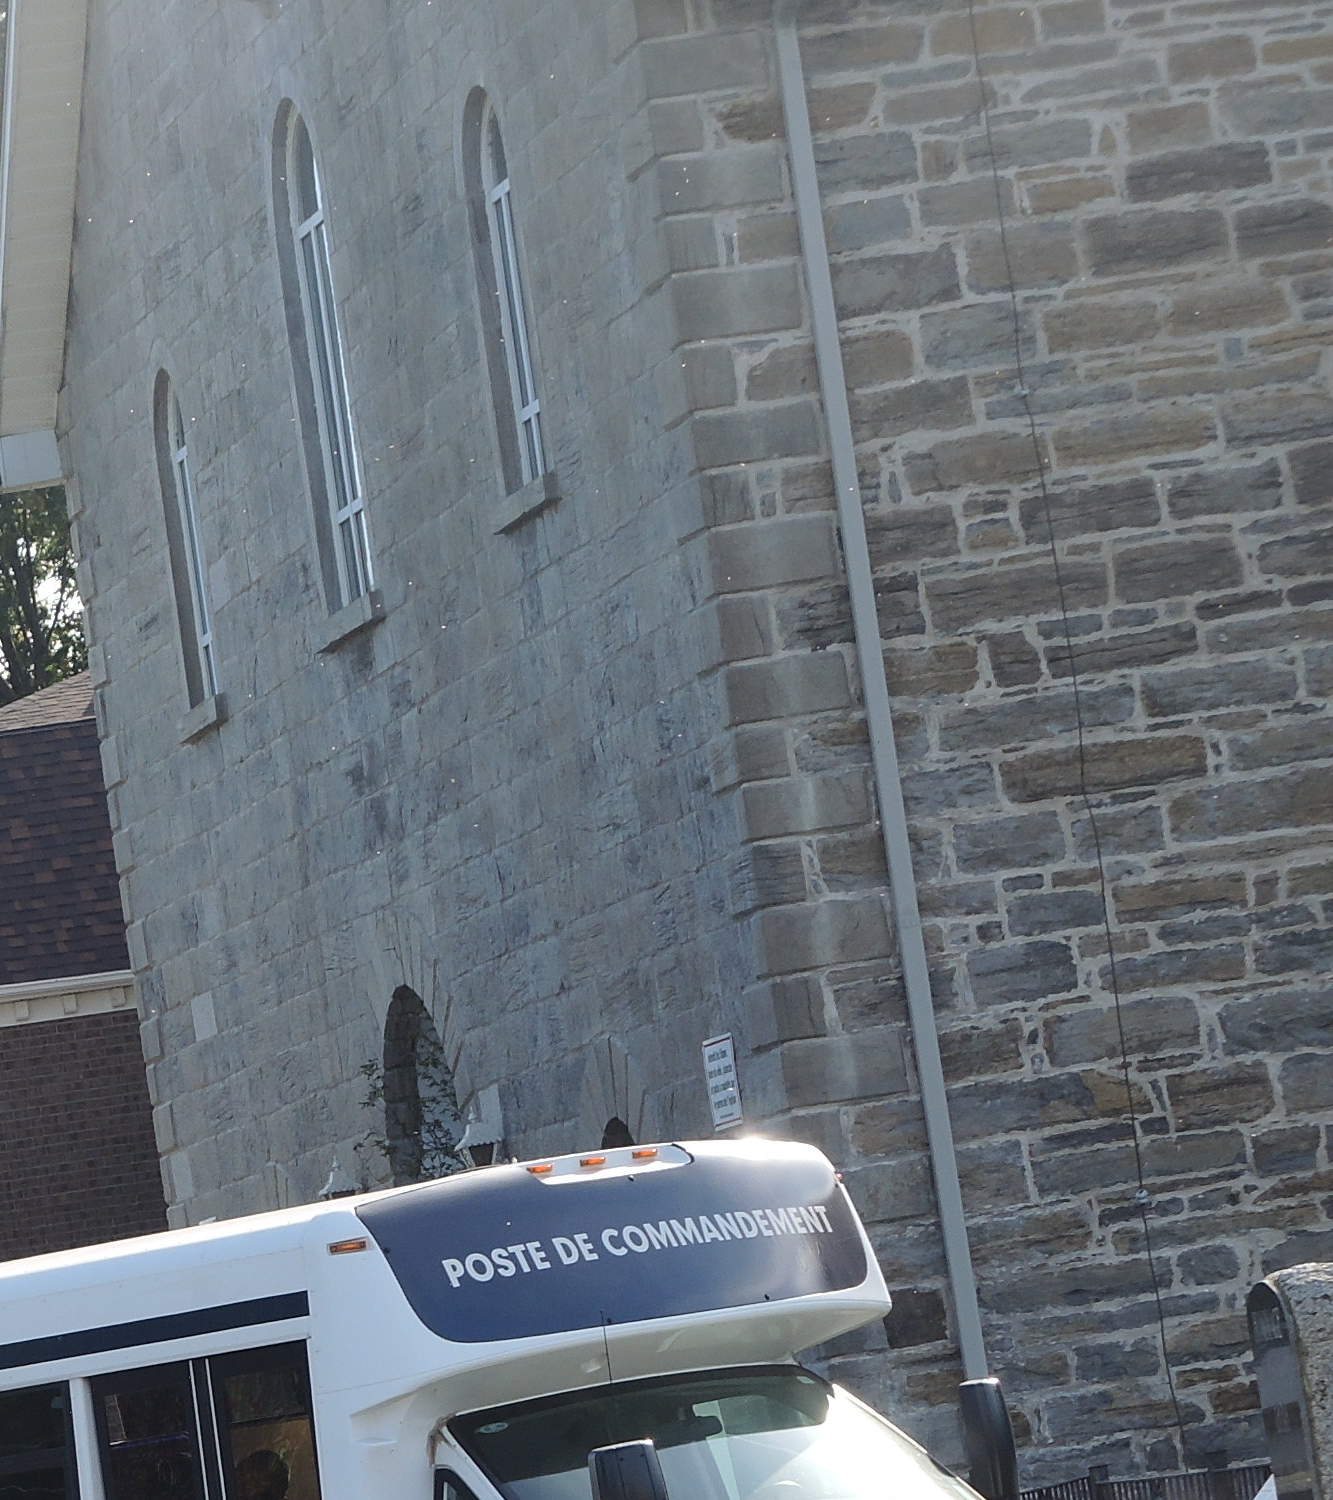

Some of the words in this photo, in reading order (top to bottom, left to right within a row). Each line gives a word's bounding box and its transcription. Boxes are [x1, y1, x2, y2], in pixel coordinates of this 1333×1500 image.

[442, 1241, 551, 1287] POSTE
[552, 1233, 598, 1264] DE
[601, 1205, 834, 1256] COMMANDEMENT
